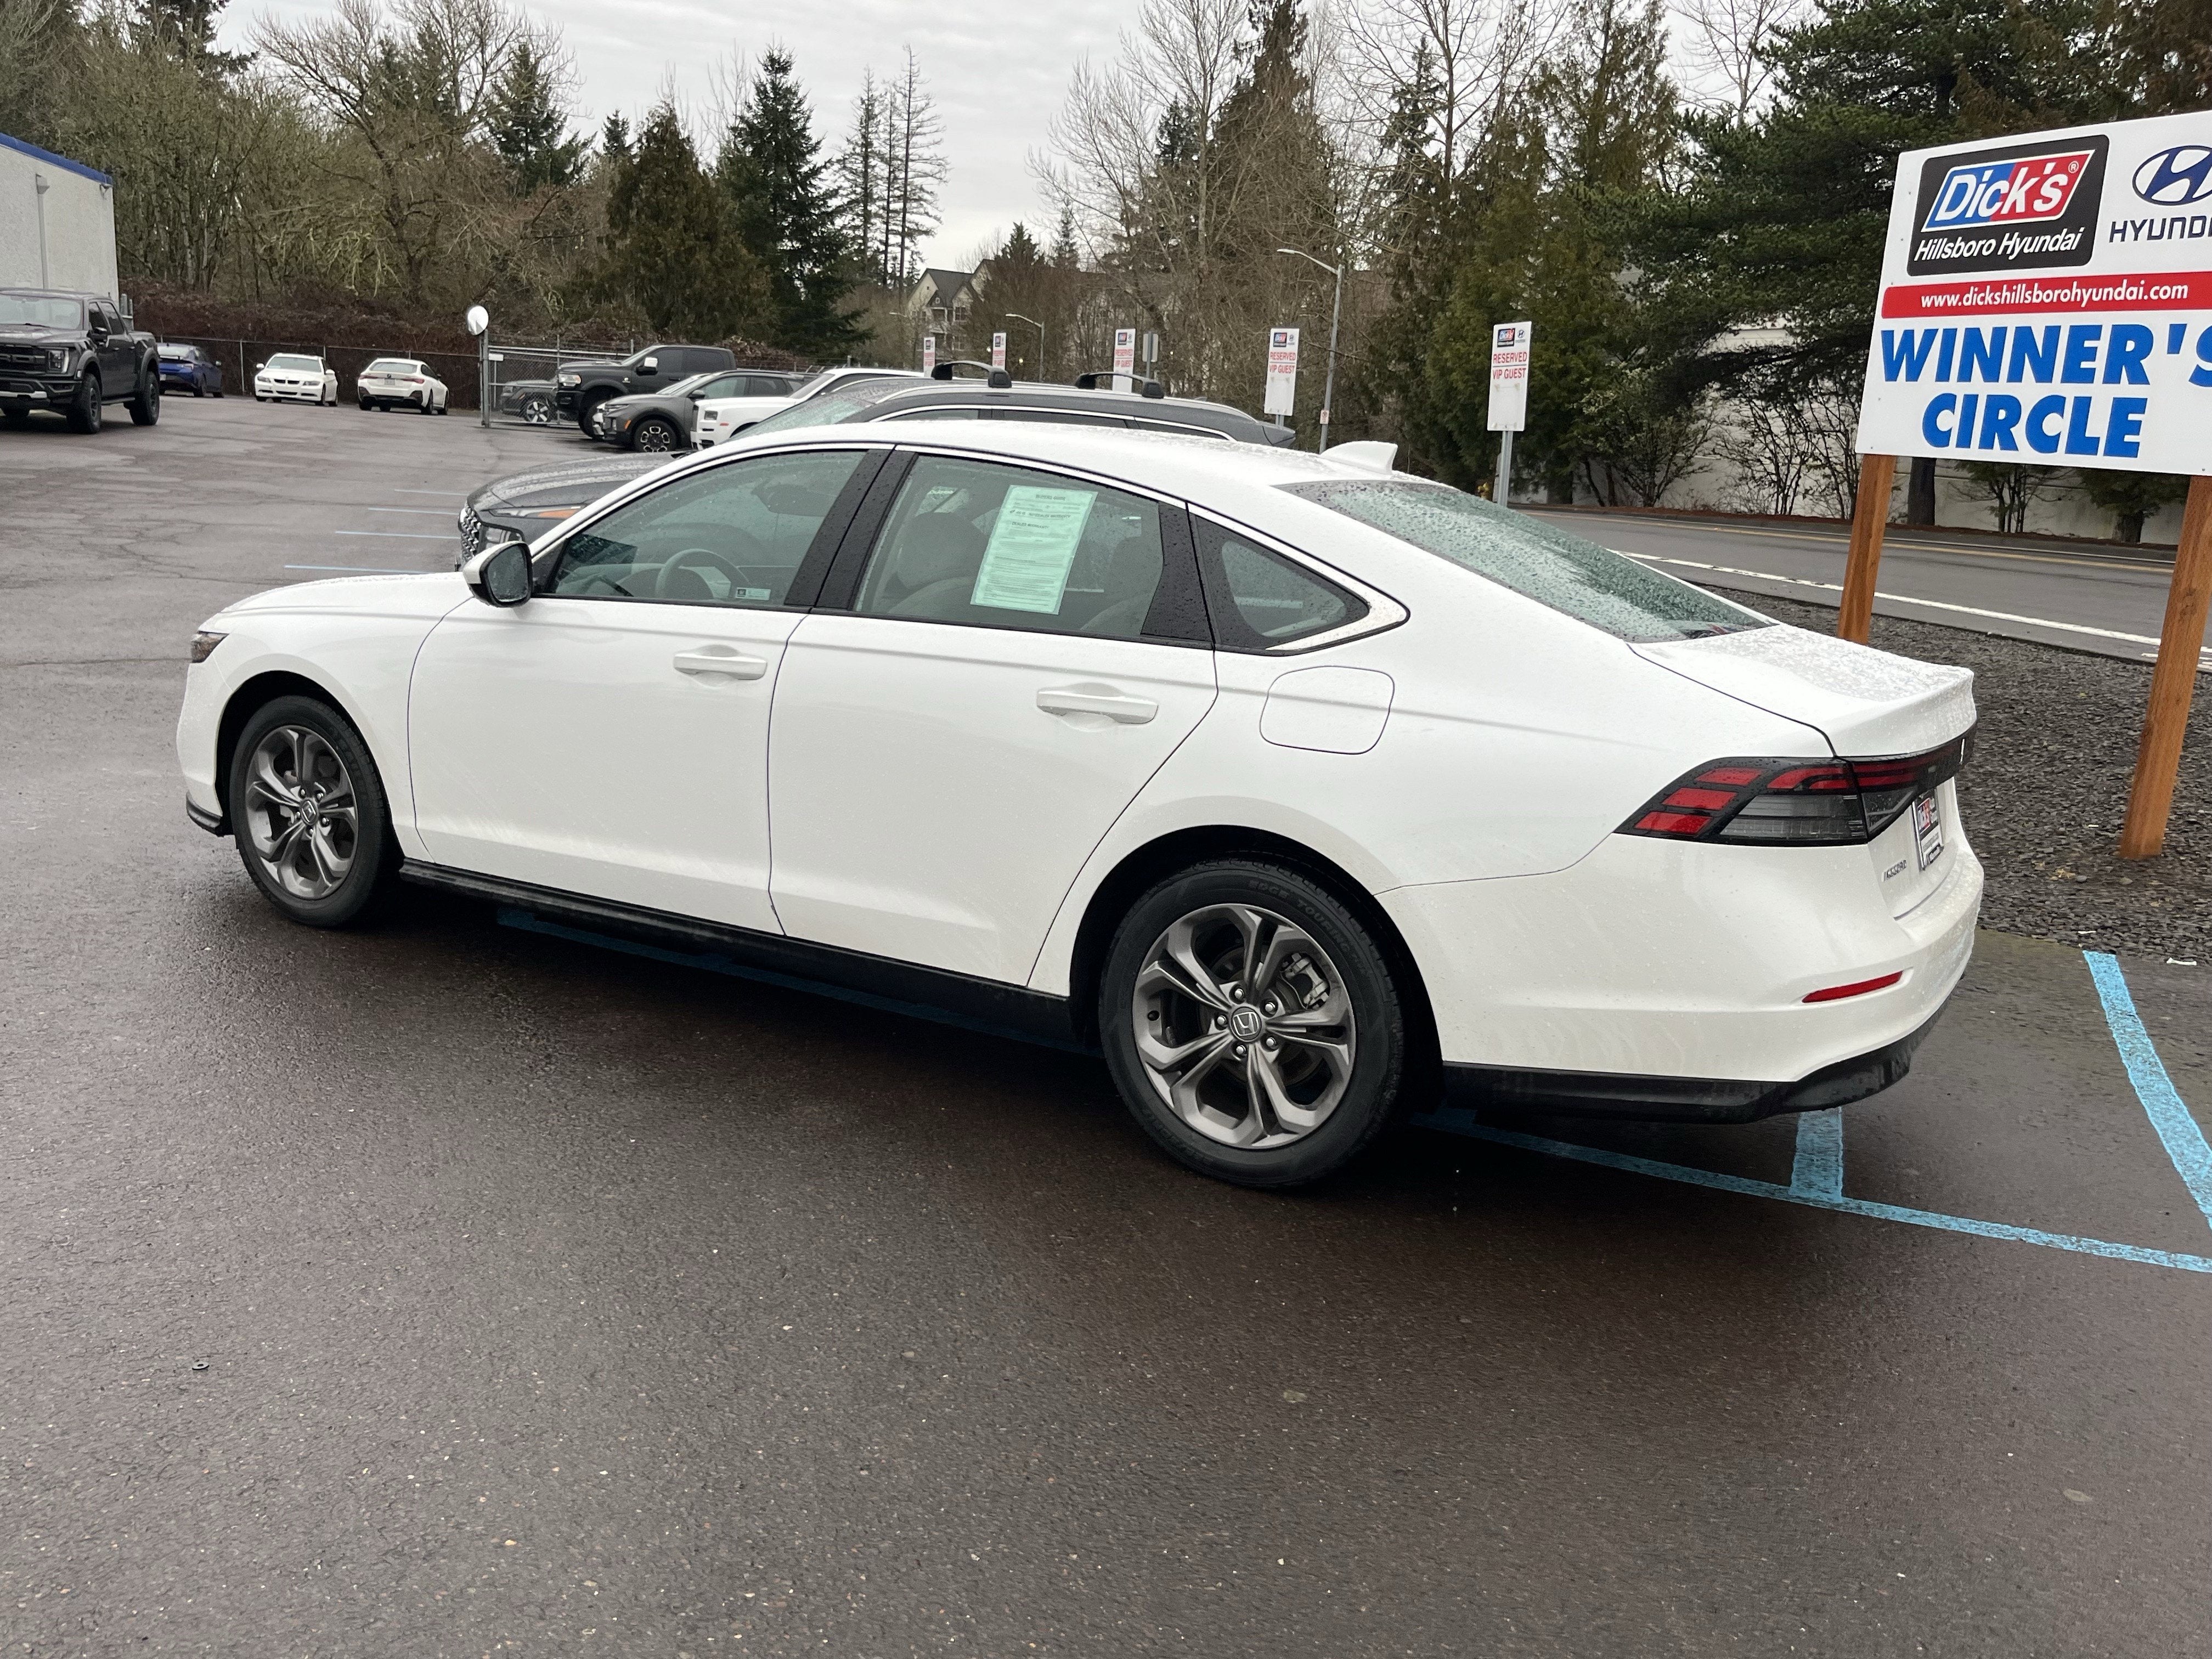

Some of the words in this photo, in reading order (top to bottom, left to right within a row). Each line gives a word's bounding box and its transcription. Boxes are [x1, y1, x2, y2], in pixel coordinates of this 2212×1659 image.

[1934, 162, 2068, 222] Dick's
[2109, 215, 2212, 243] HYUND
[1914, 236, 1995, 261] Hillsboro
[1997, 227, 2085, 261] Hyundai
[1920, 279, 2188, 308] www.dickshillsborohyundai.com
[1493, 352, 1527, 364] RESERVED
[1492, 369, 1502, 379] VIP
[1504, 368, 1526, 379] GUEST
[1922, 393, 2148, 458] CIRCLE
